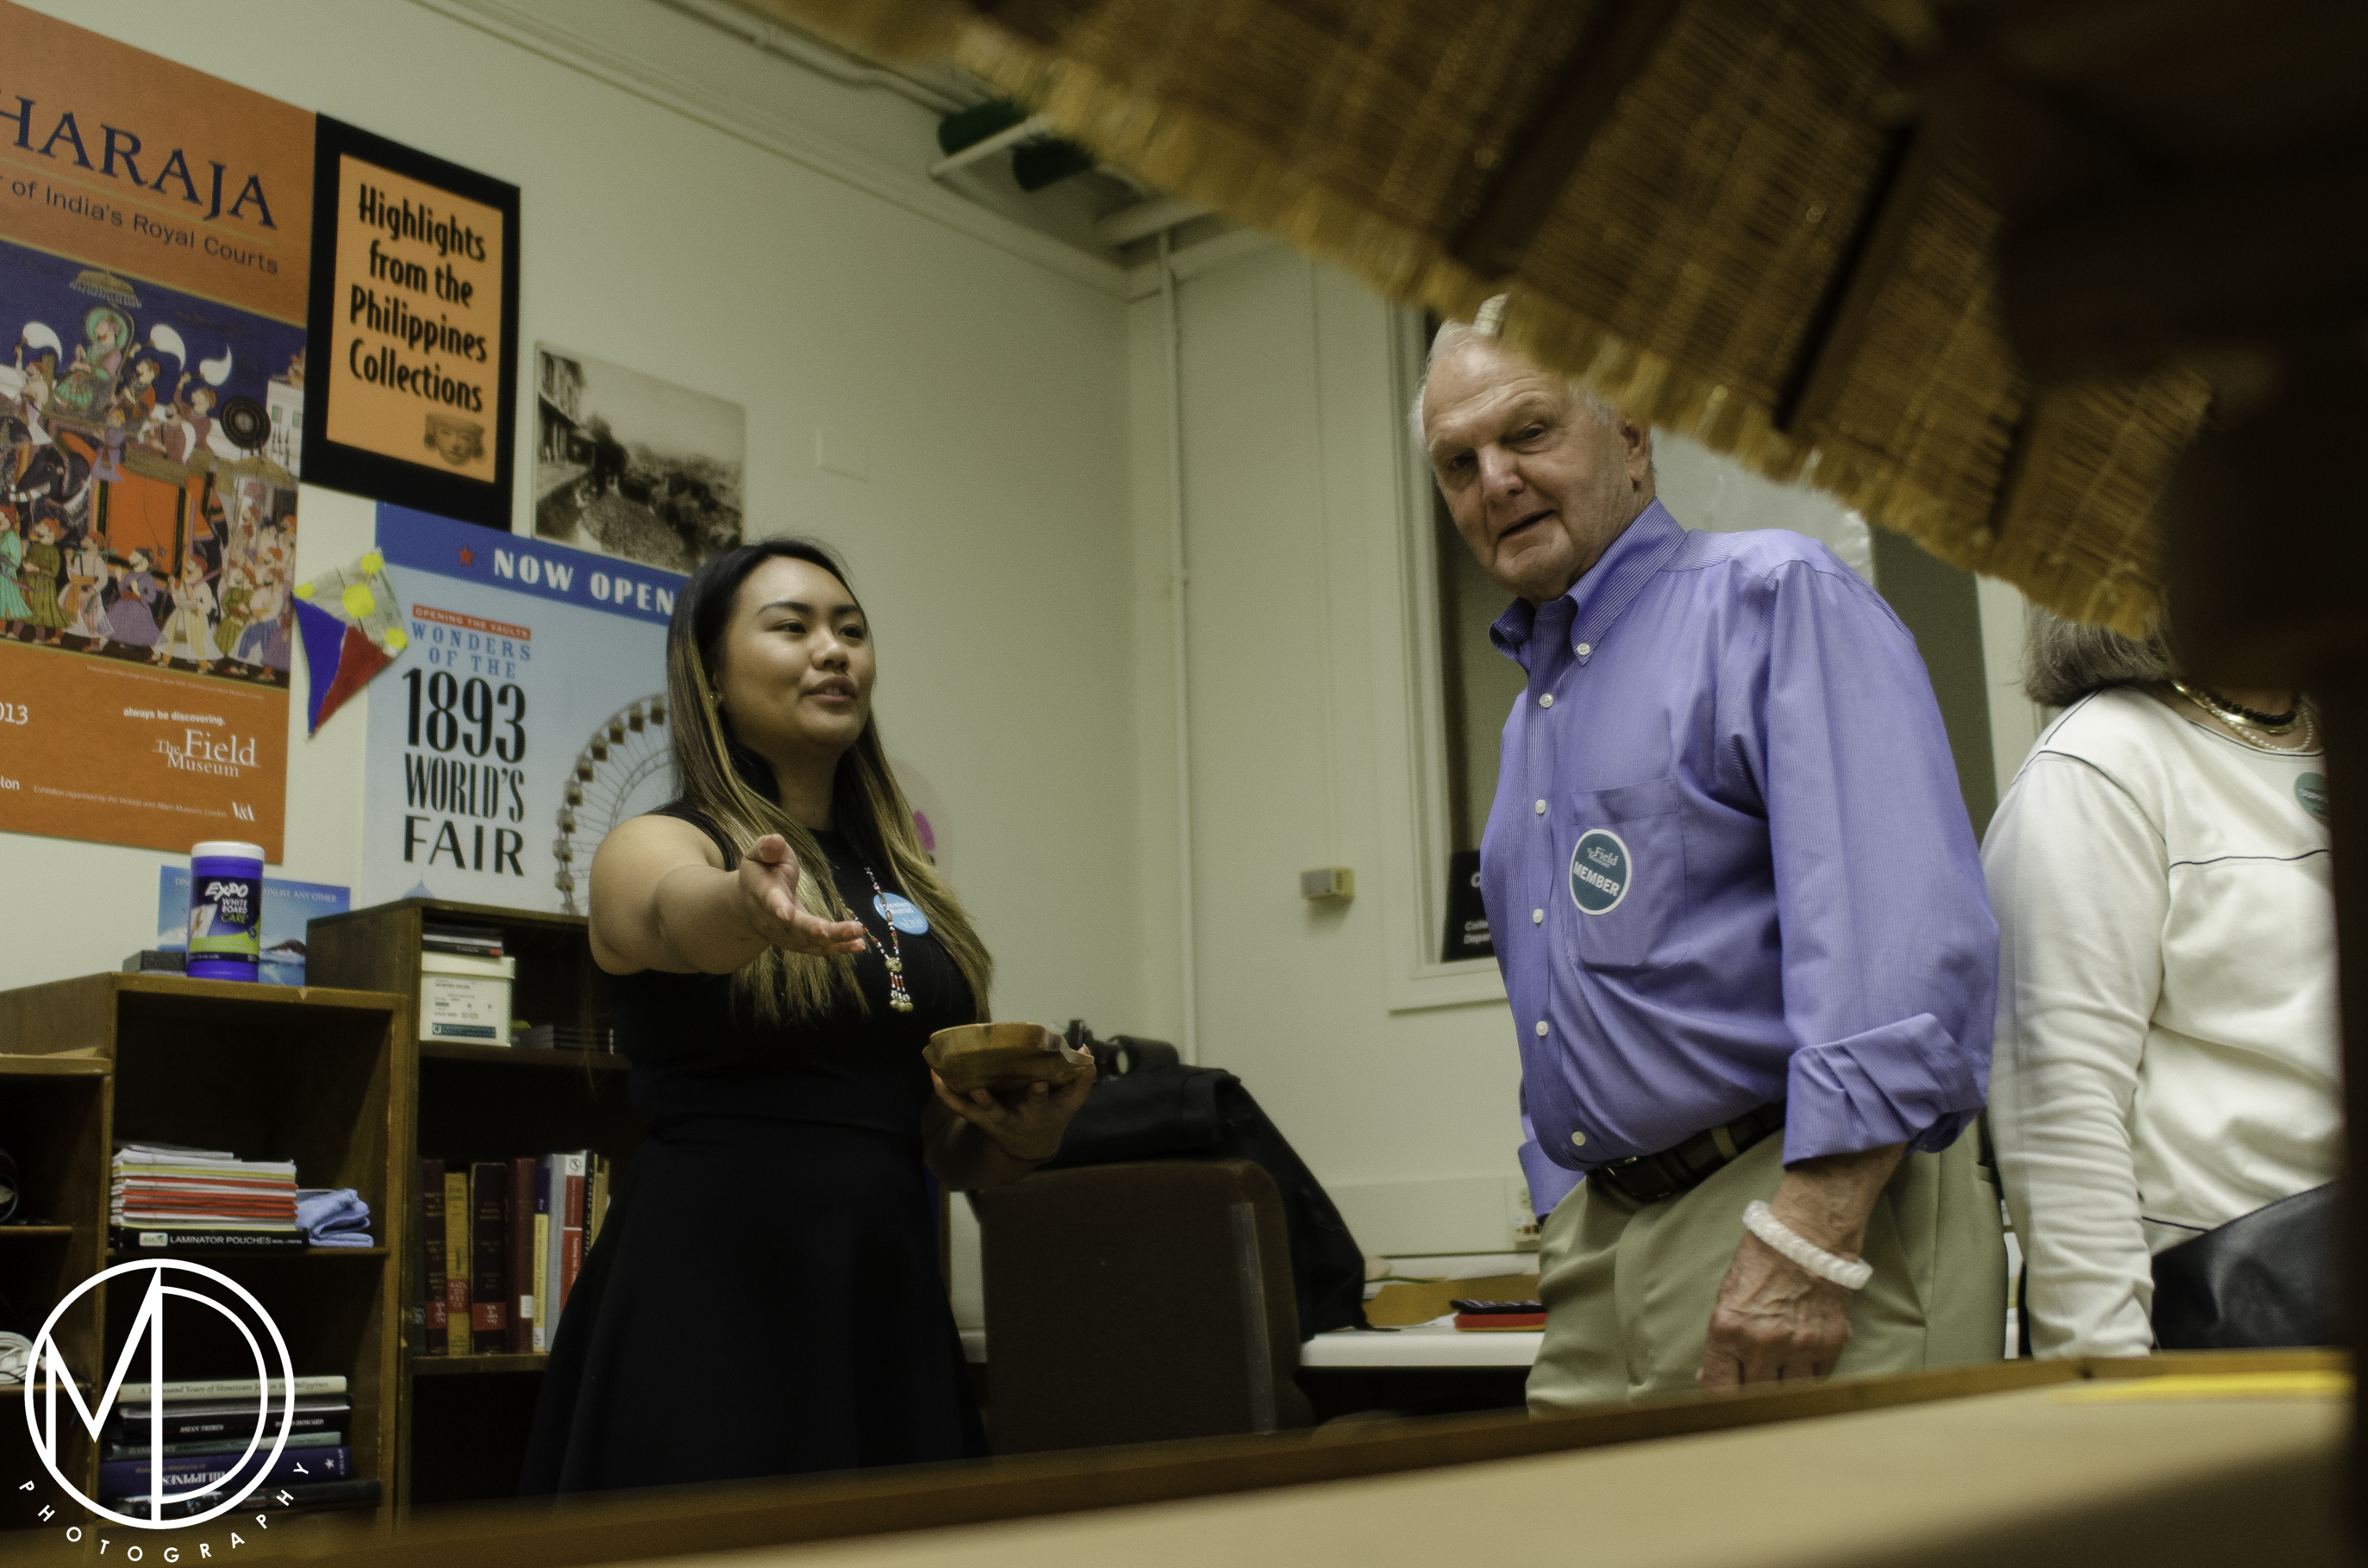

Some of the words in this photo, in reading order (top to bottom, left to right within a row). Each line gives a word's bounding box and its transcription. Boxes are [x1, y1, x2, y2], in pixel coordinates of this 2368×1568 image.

[11, 178, 37, 199] of
[46, 185, 123, 228] India's
[134, 212, 195, 247] Royal
[203, 236, 278, 276] Courts
[359, 182, 486, 263] Highlights
[370, 240, 428, 294] from
[434, 263, 473, 309] the
[350, 284, 488, 364] Philippines
[349, 338, 483, 413] Collections
[494, 547, 575, 592] NOW
[590, 572, 674, 616] OPEN
[415, 607, 464, 626] OPENING
[467, 618, 487, 630] THE
[490, 623, 528, 637] VAULTS
[411, 622, 531, 661] WONDERS
[428, 647, 457, 667] OF
[470, 653, 515, 679] THE
[123, 707, 156, 722] always
[157, 709, 170, 722] be
[402, 667, 526, 765] 1893
[156, 739, 180, 755] The
[185, 728, 256, 766] Field
[167, 753, 240, 778] Museum
[404, 752, 525, 824] WORLD'S
[404, 815, 524, 878] FAIR
[1595, 846, 1619, 866] Field
[204, 881, 249, 902] EXPO
[1573, 861, 1621, 896] MEMBER
[221, 905, 248, 915] BOARD
[221, 914, 246, 924] CARE
[222, 897, 248, 907] WHITE
[170, 1235, 224, 1245] LAMINATOR
[226, 1236, 272, 1246] POUCHES
[162, 1471, 225, 1486] HILIPPINES
